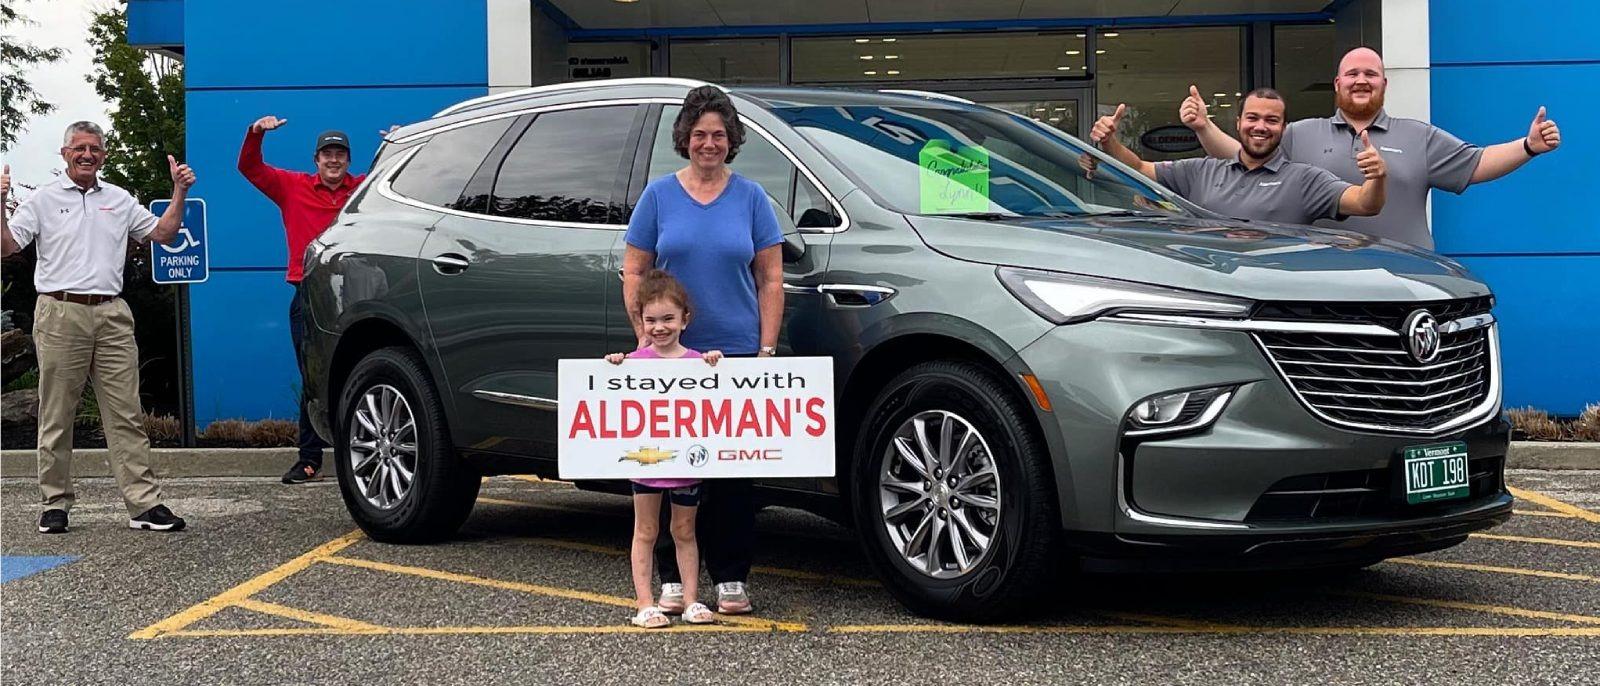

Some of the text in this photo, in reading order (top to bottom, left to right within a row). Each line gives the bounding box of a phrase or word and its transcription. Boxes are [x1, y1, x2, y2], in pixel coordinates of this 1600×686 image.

[160, 255, 199, 267] PARKING
[168, 268, 192, 278] ONLY
[588, 372, 806, 394] I stayed with
[568, 397, 826, 439] ALDERMAN'S
[718, 449, 783, 461] GMC
[1424, 447, 1450, 457] Vermont
[1412, 457, 1464, 489] KDT 198
